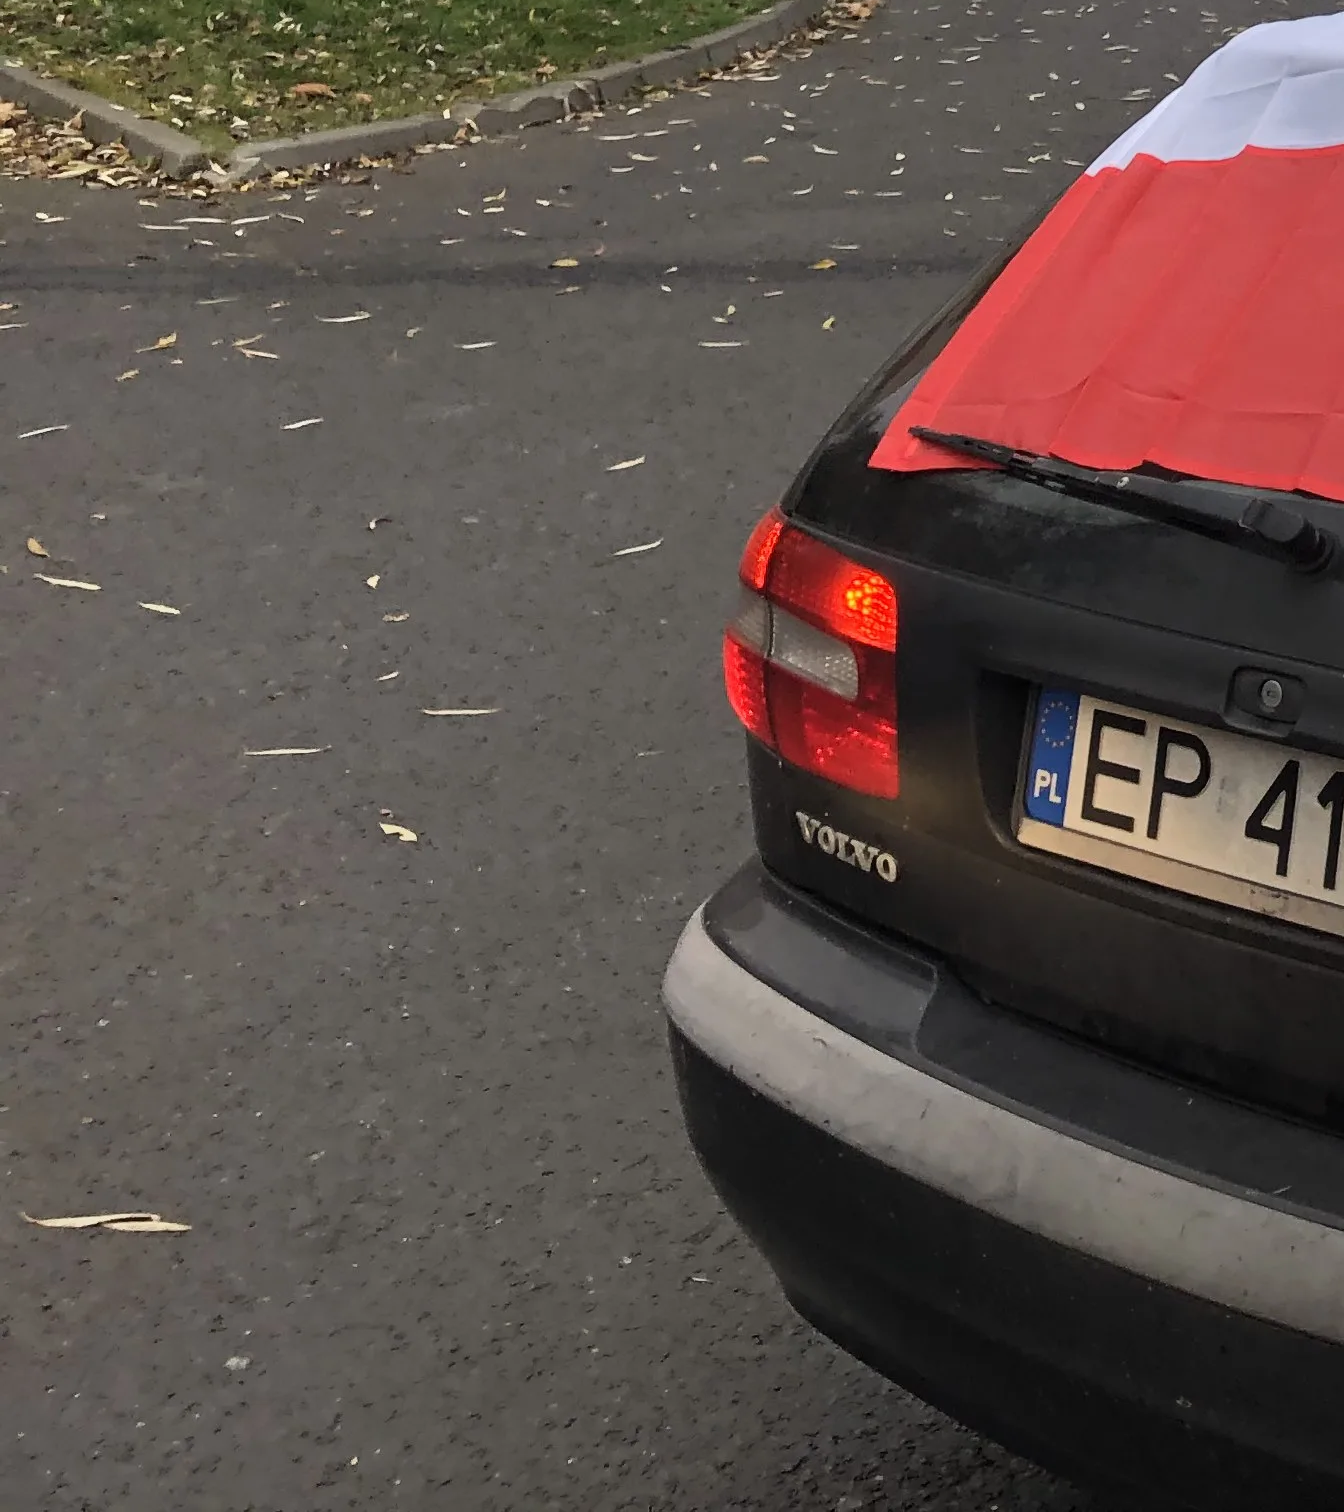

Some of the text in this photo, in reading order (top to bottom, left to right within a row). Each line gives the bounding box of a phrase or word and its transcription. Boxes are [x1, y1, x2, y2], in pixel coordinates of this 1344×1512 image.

[1033, 768, 1062, 804] PL
[1081, 708, 1211, 840] EP
[795, 811, 898, 883] VOLVO
